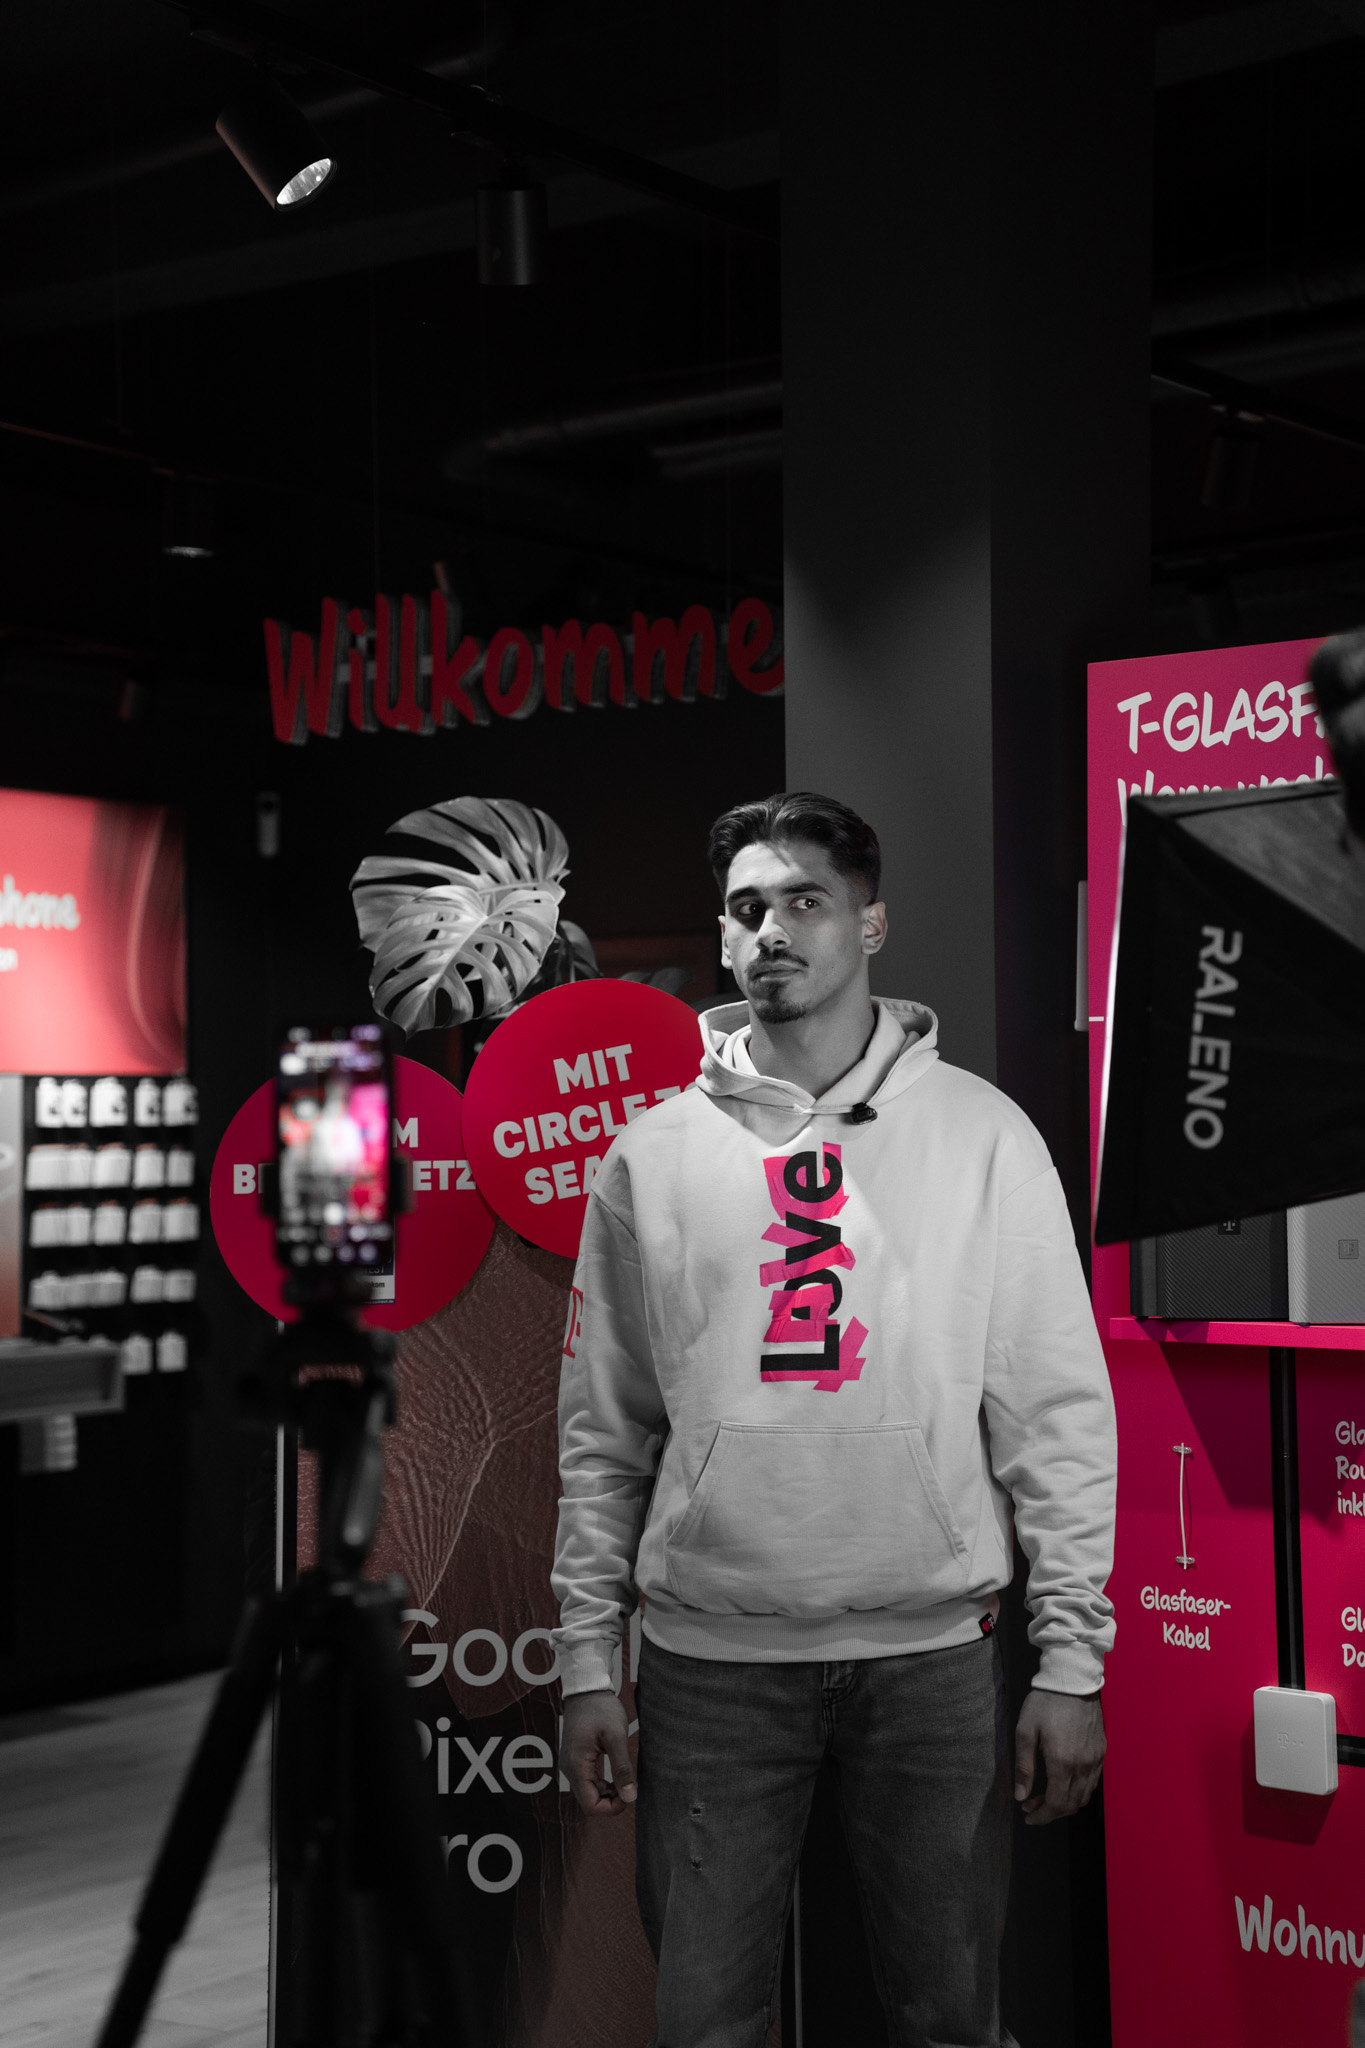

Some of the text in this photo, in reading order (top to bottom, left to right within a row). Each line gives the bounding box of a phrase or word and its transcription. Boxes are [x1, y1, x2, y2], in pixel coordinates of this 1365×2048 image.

[1183, 924, 1244, 1150] RALENO
[553, 1043, 633, 1095] MIT
[392, 1117, 419, 1149] M
[411, 1160, 477, 1191] ETZ
[524, 1154, 603, 1205] SEA
[760, 1151, 843, 1373] Love
[1140, 1585, 1231, 1616] Glasfaser-
[400, 1608, 641, 1697] Gool
[1163, 1621, 1211, 1651] Kabel
[439, 1832, 524, 1894] ro
